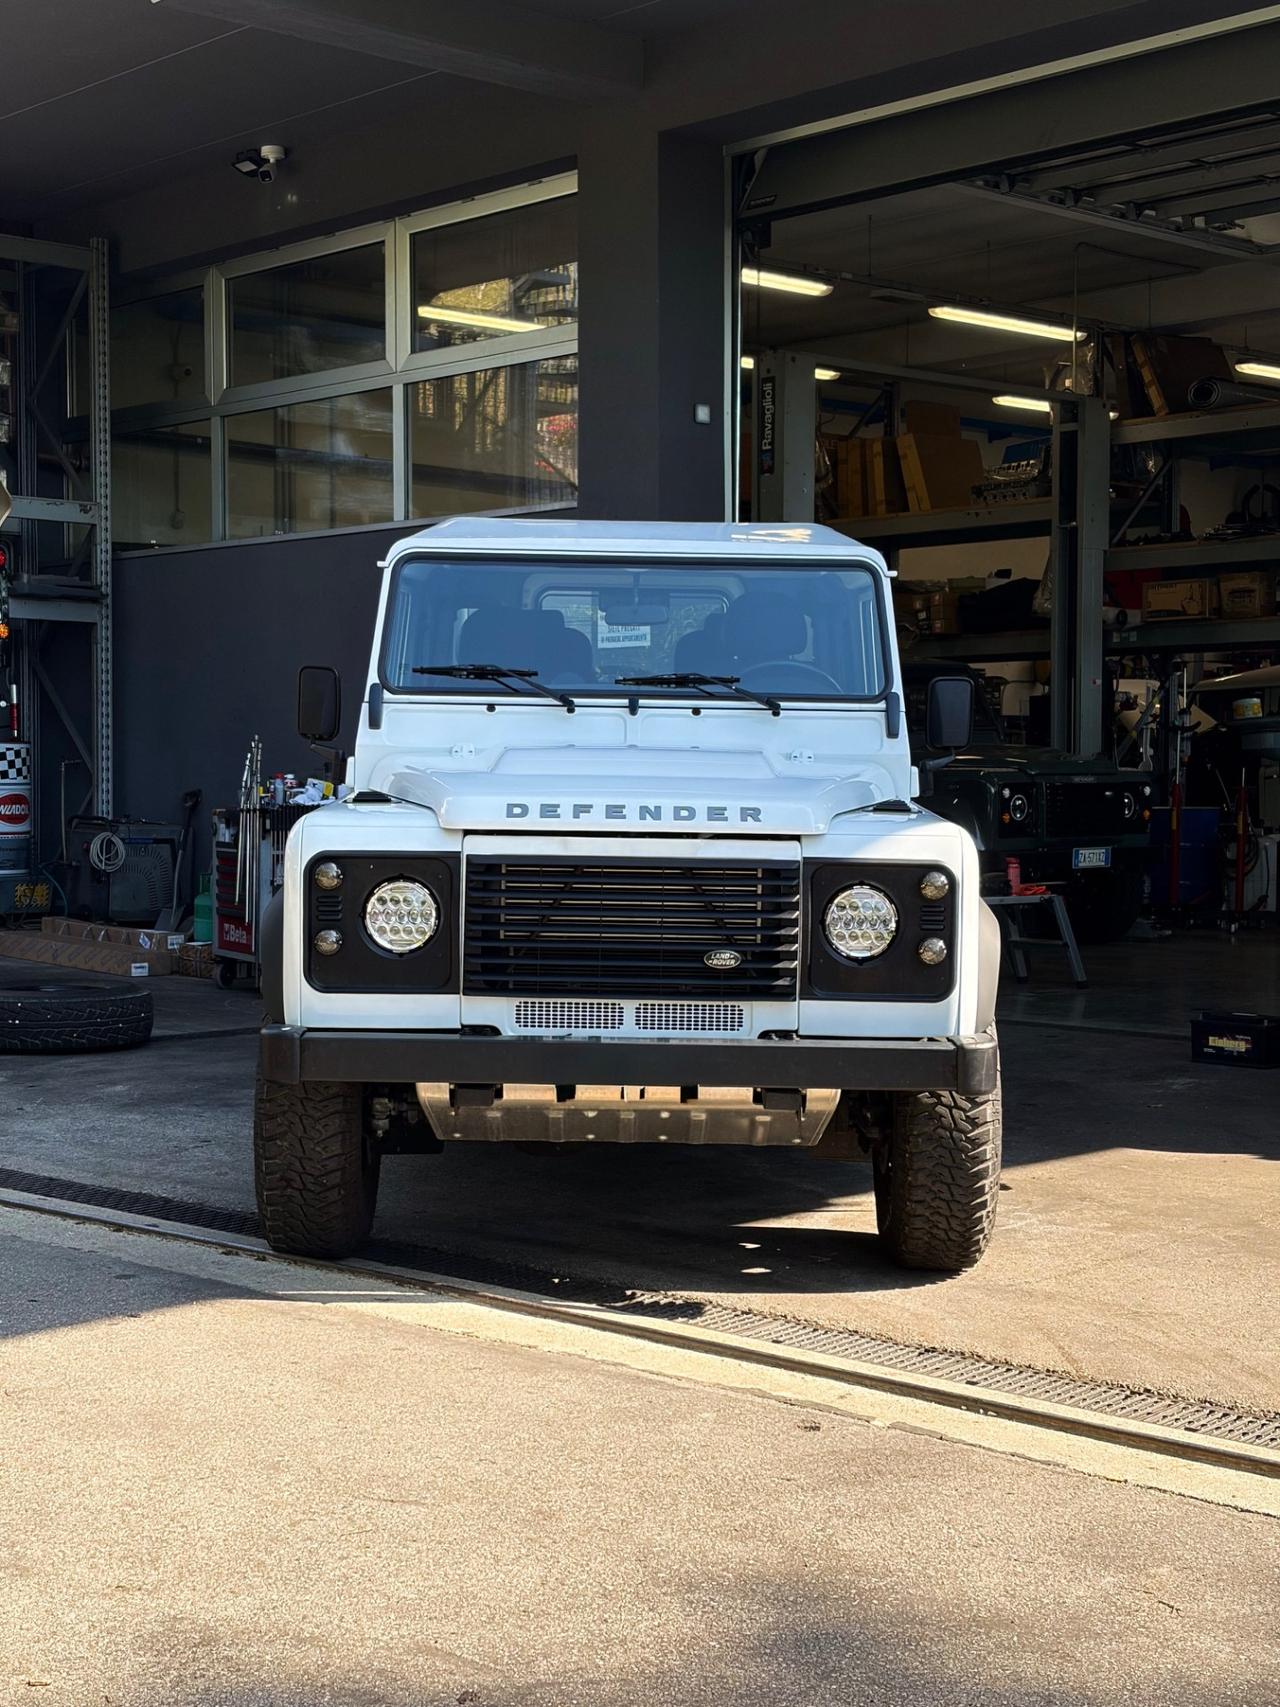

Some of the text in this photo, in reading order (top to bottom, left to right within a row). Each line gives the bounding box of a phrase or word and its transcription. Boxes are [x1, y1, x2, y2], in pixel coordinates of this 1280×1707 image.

[762, 383, 775, 450] Ravaglioli
[506, 803, 762, 823] DEFENDER
[229, 924, 247, 944] Beta
